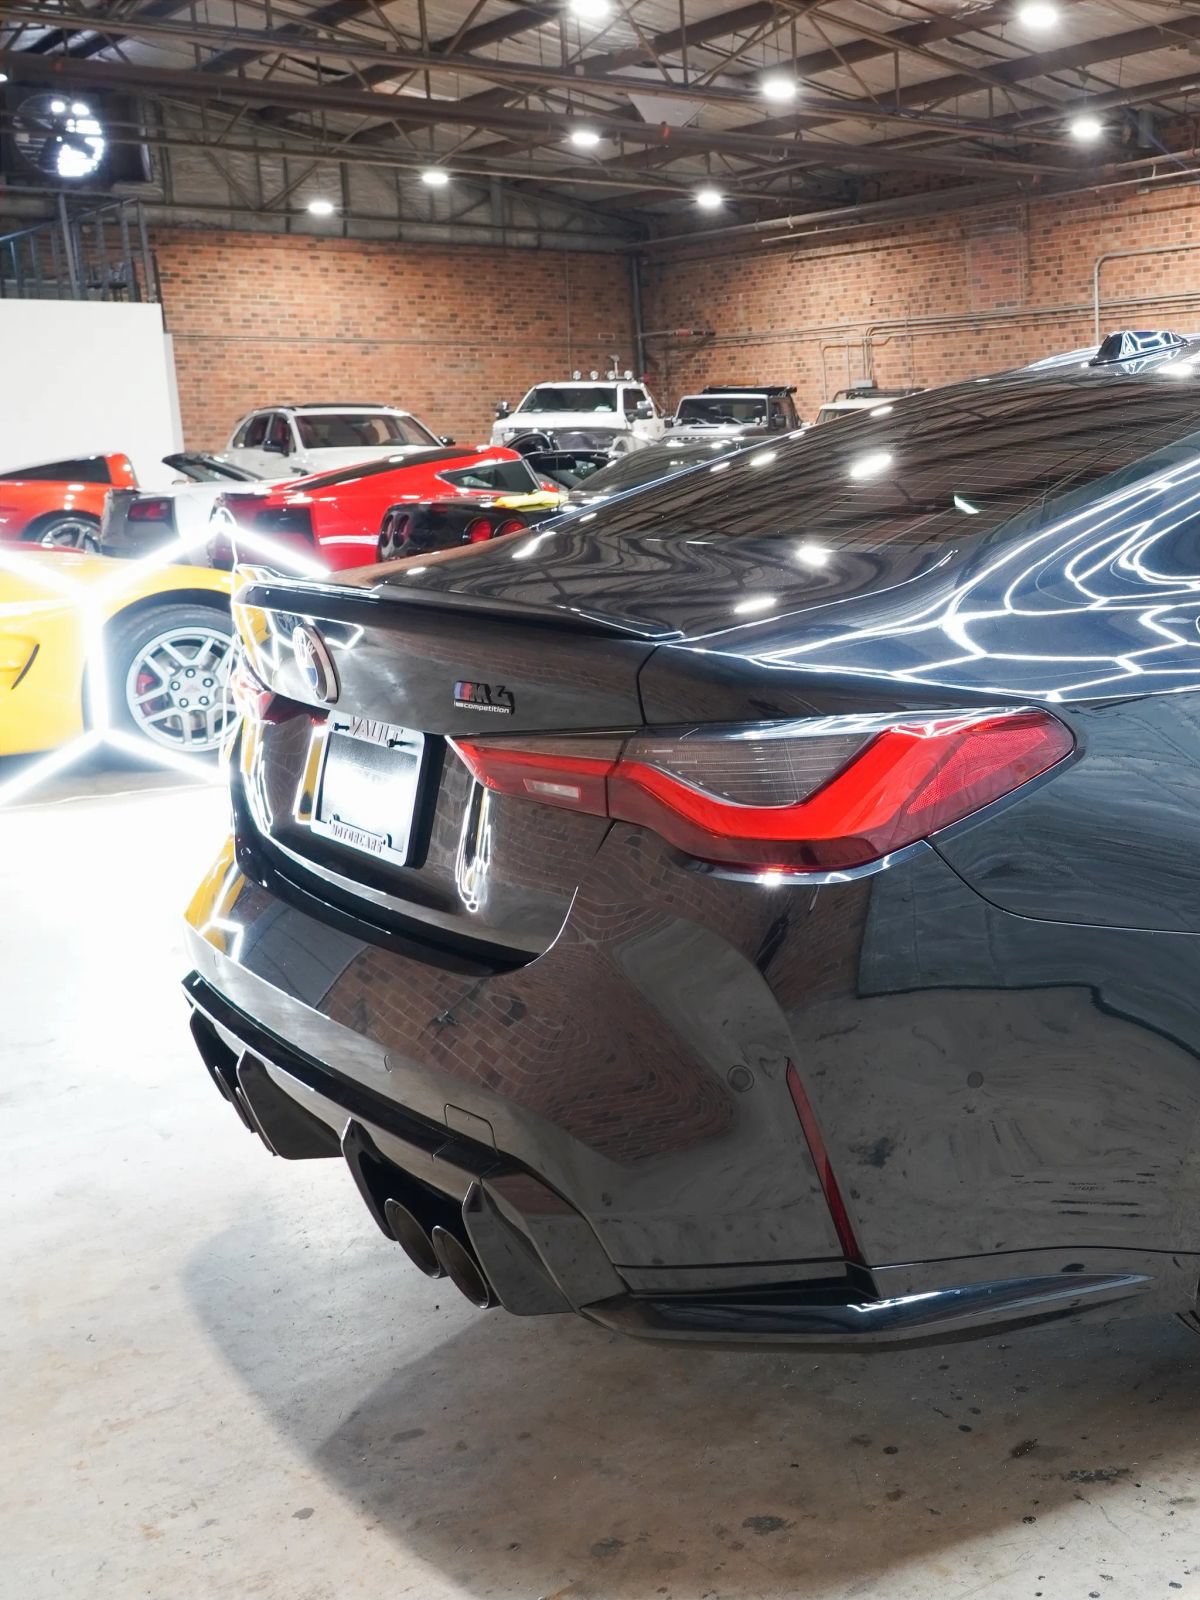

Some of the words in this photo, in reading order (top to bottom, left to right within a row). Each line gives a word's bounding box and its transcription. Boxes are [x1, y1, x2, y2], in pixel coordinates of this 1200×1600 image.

[463, 702, 510, 714] competition
[351, 715, 404, 744] VAULT
[332, 822, 384, 854] MOTORCARS
